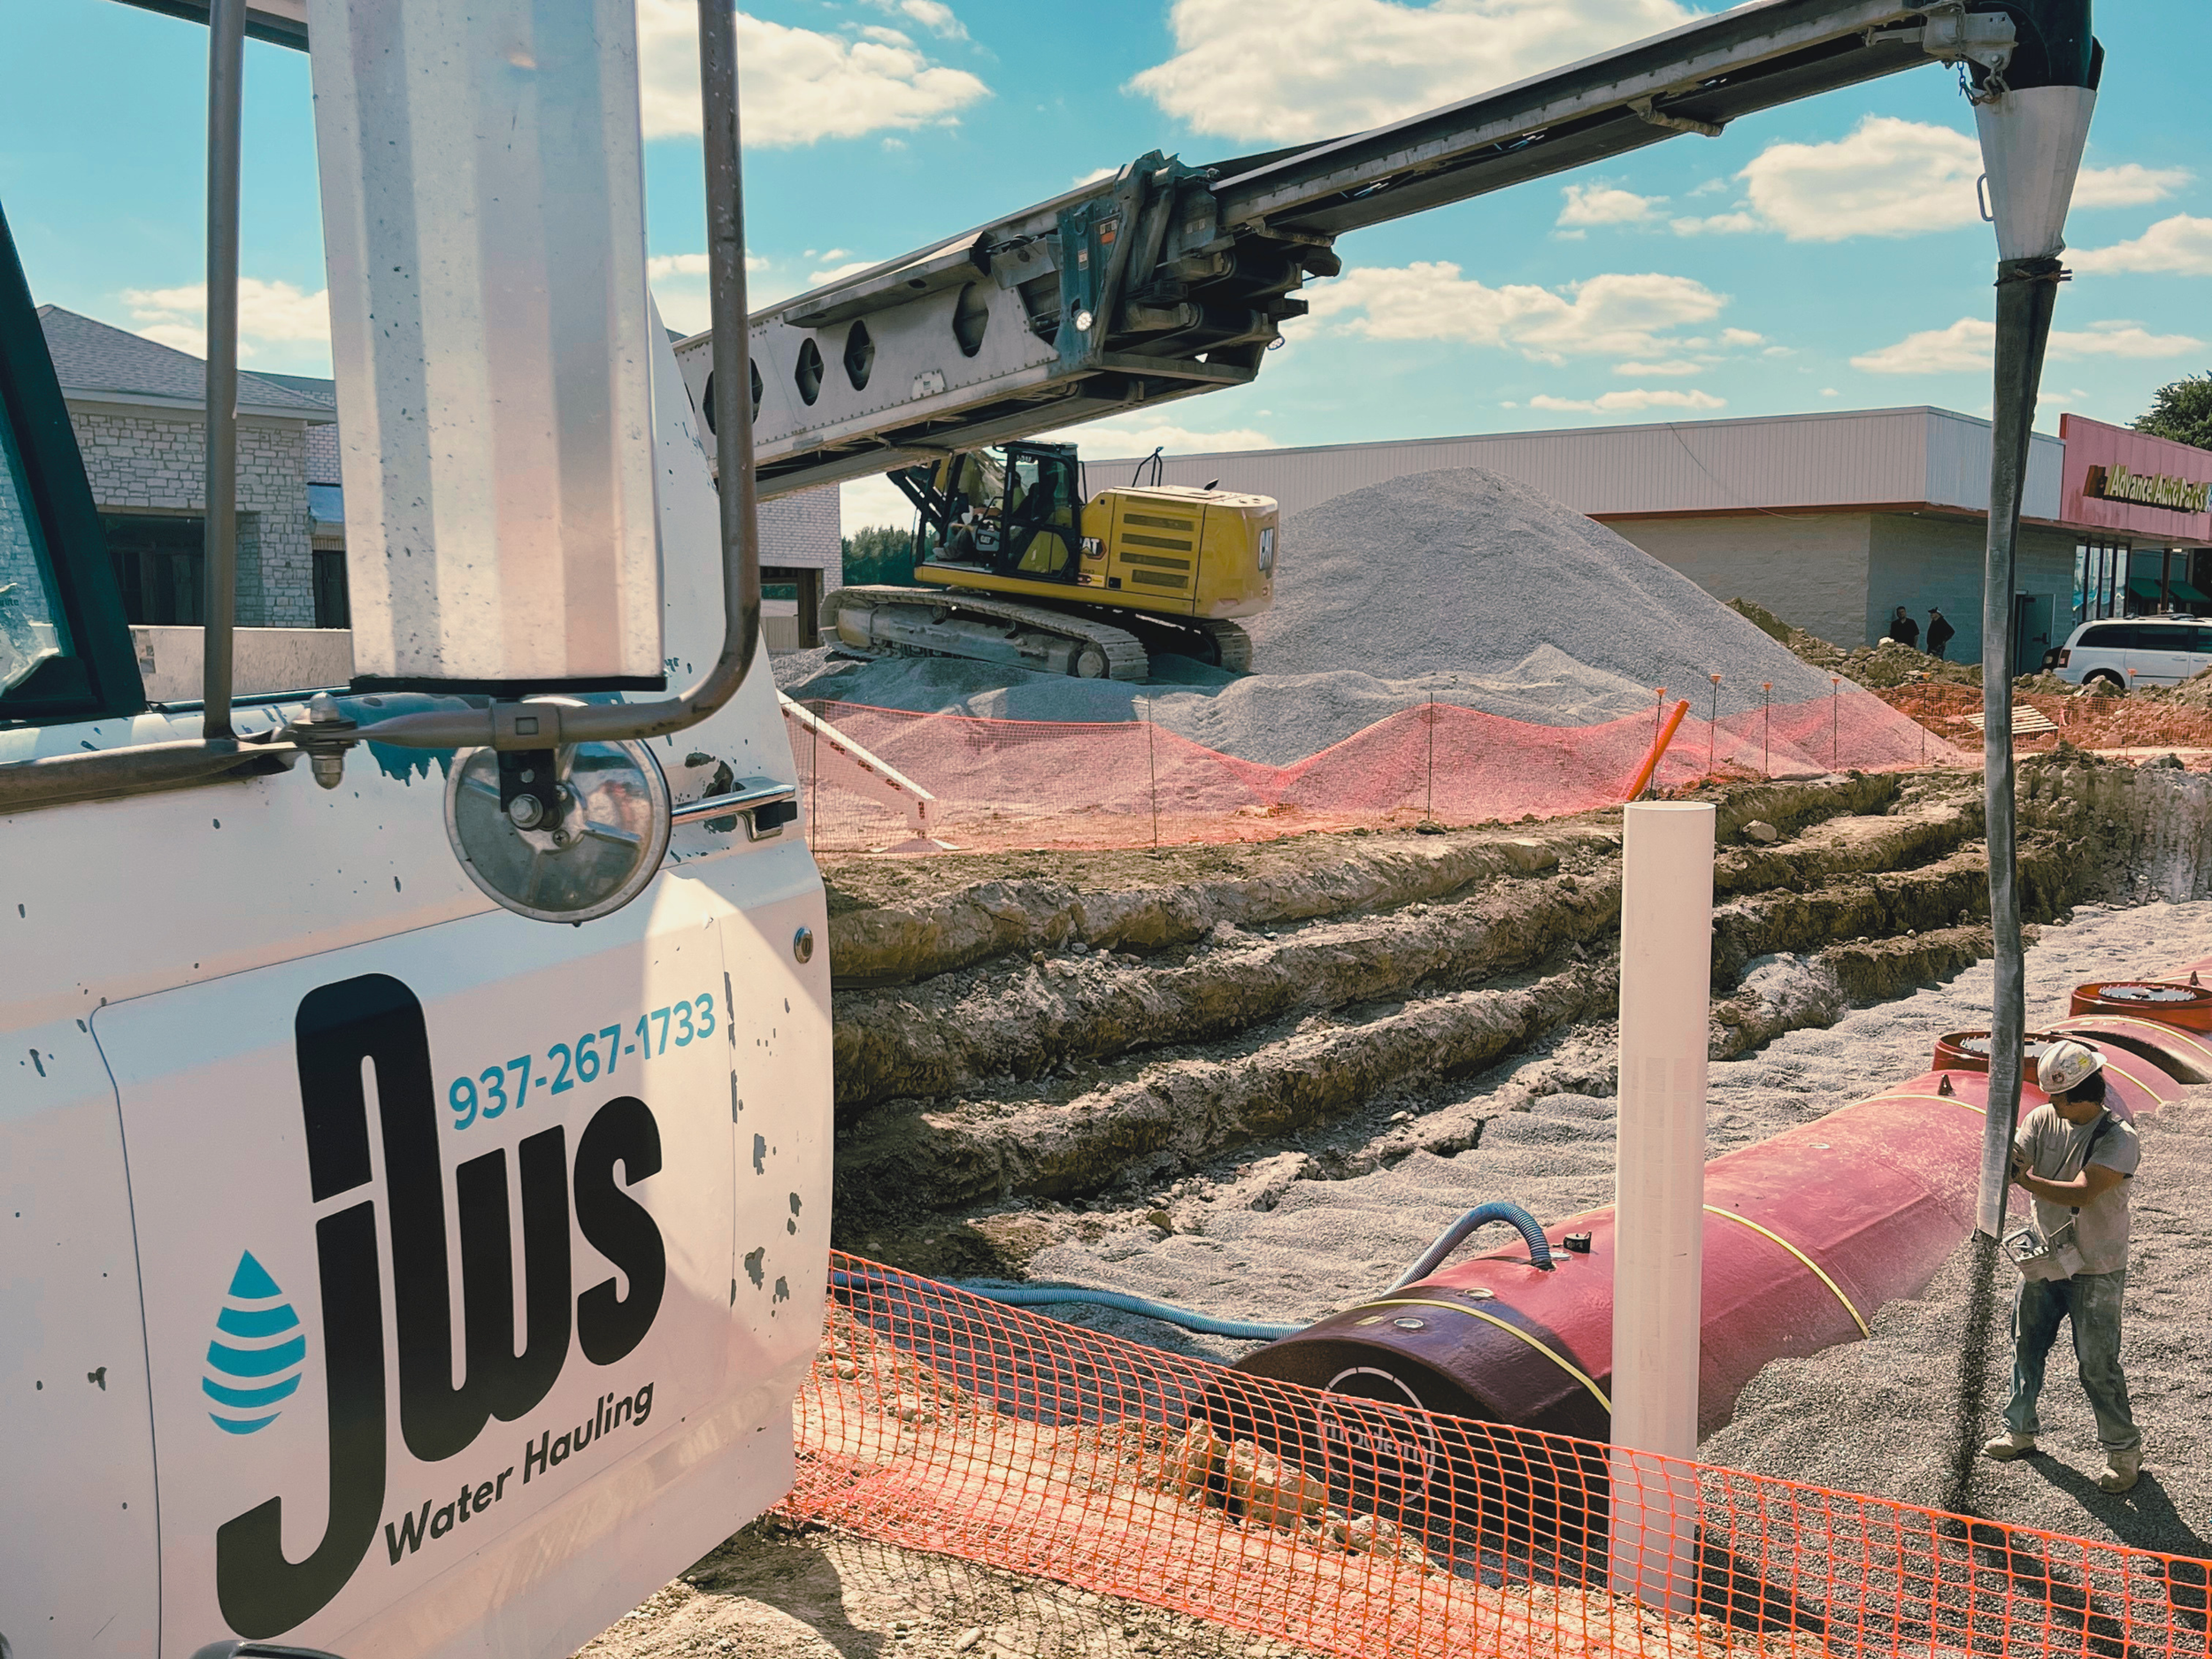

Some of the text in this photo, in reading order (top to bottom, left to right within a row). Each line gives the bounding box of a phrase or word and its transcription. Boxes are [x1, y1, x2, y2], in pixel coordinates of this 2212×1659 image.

[2107, 464, 2205, 511] Advance Auto Parts
[1079, 537, 1101, 555] AT
[1259, 528, 1274, 570] CAT
[449, 993, 716, 1131] 937-267-1733
[384, 1382, 655, 1566] Water Hauling
